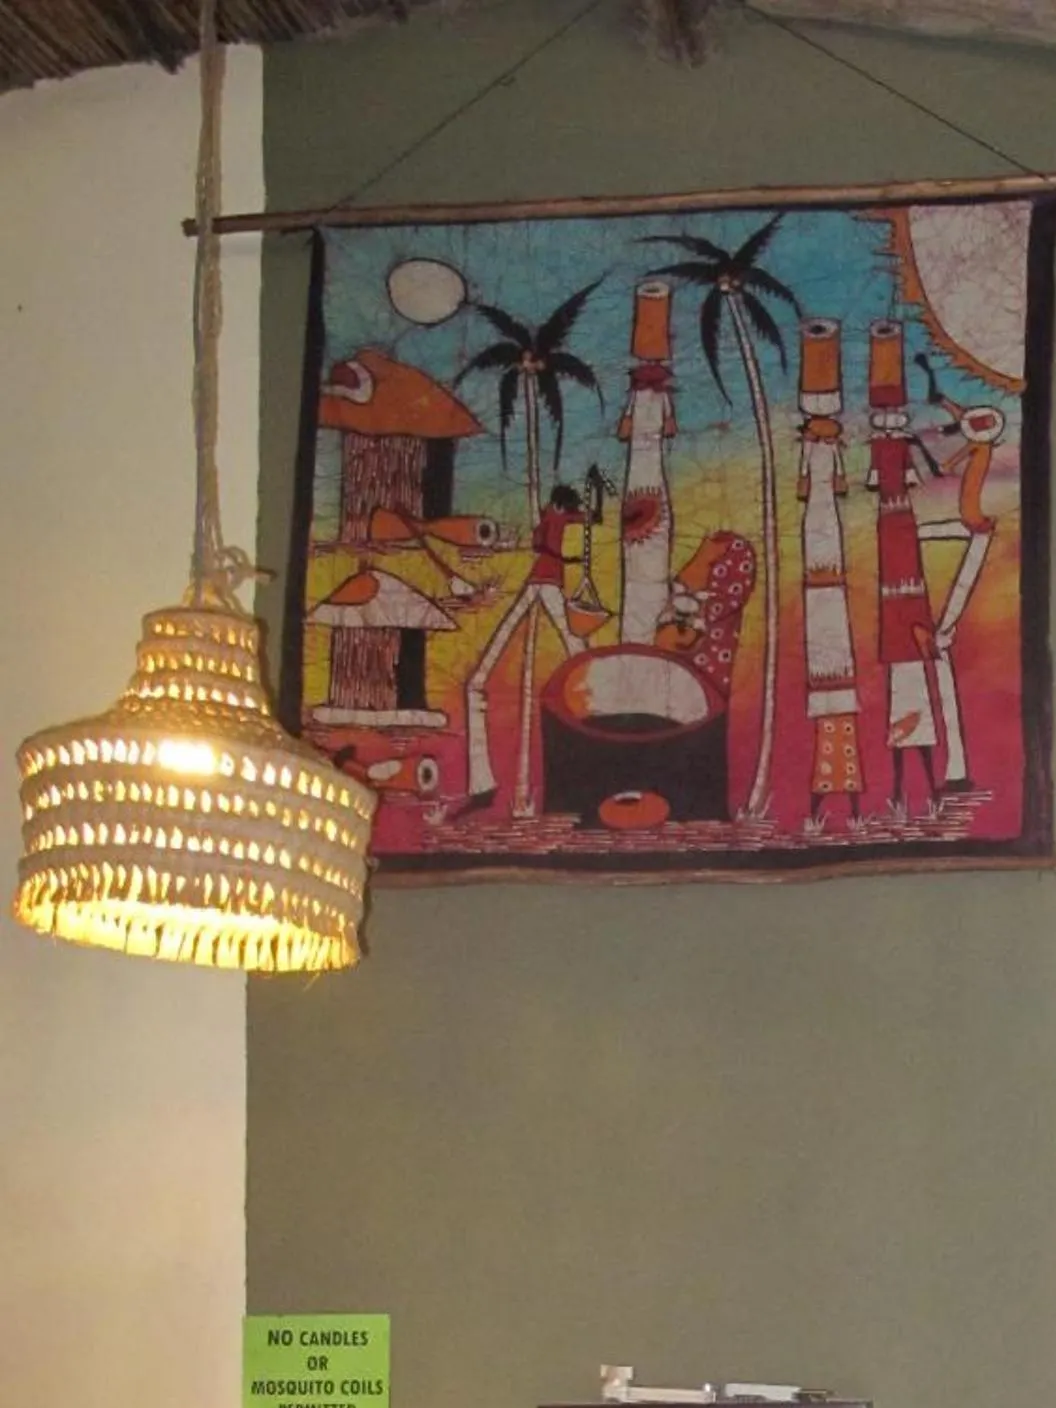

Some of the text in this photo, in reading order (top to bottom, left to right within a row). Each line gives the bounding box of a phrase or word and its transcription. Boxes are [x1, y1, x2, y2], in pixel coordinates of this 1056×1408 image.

[267, 1329, 369, 1347] NO CANDLES
[307, 1355, 329, 1371] OR
[251, 1379, 384, 1396] MOSQUITO COILS
